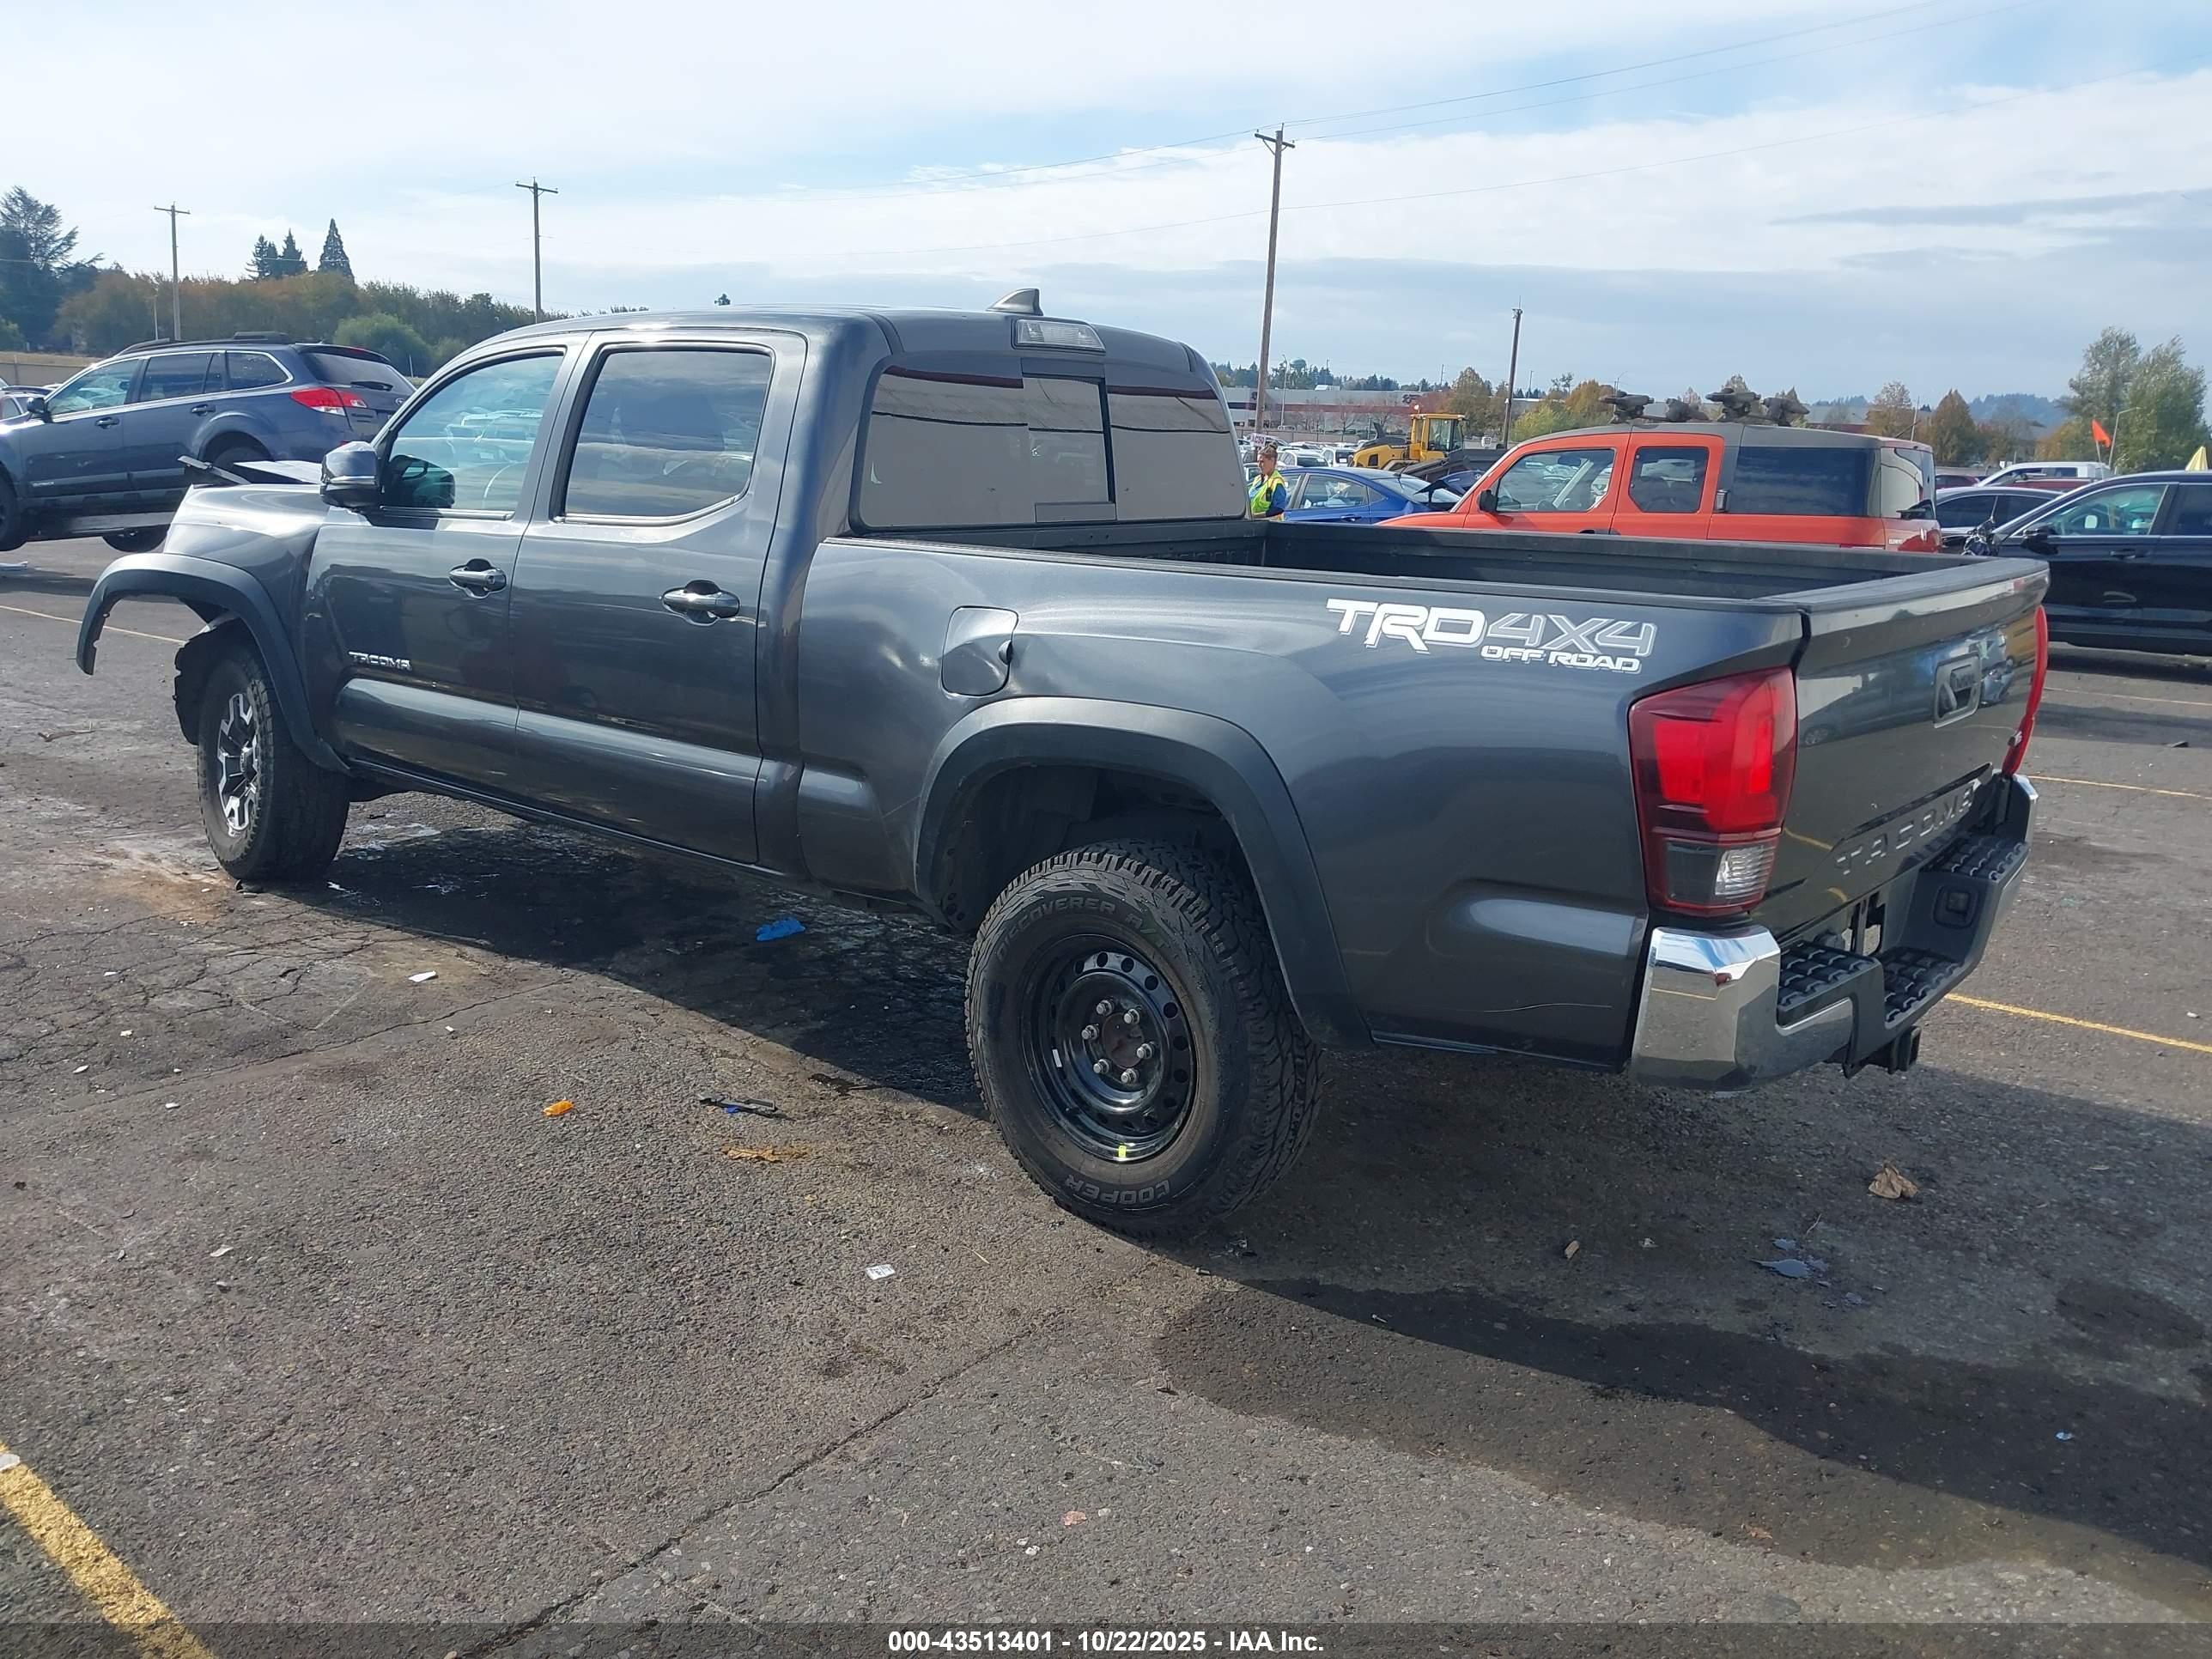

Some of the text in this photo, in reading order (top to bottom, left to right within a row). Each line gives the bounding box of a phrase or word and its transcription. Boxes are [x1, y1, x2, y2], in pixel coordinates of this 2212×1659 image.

[1326, 597, 1487, 655] TRD
[348, 651, 412, 671] TACOMA
[1480, 645, 1643, 675] OFF ROAD
[995, 896, 1116, 963] DISCOVERER
[1064, 1174, 1170, 1205] COOPER
